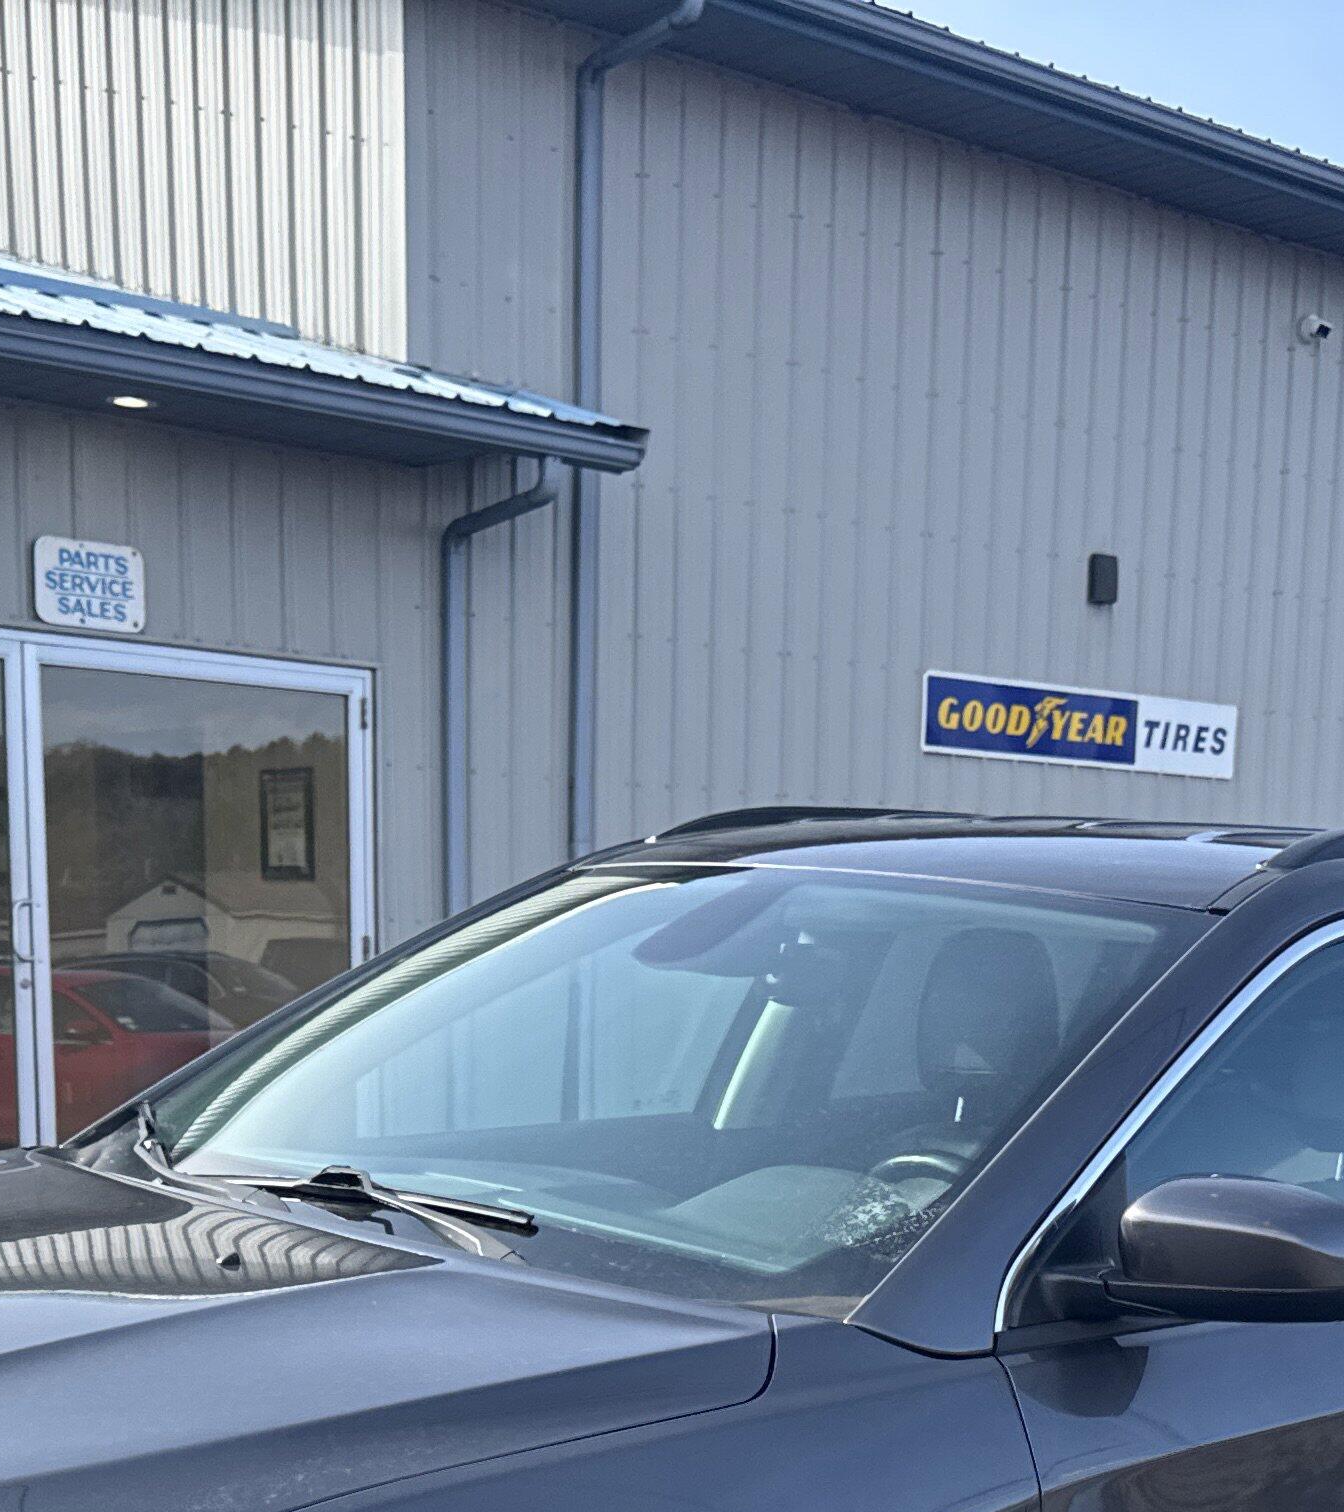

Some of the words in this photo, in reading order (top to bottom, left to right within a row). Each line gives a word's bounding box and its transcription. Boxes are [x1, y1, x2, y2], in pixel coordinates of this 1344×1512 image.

[58, 548, 128, 575] PARTS
[45, 570, 135, 599] SERVICE
[58, 597, 128, 622] SALES
[937, 696, 1128, 748] GOODYEAR
[1144, 720, 1227, 756] TIRES
